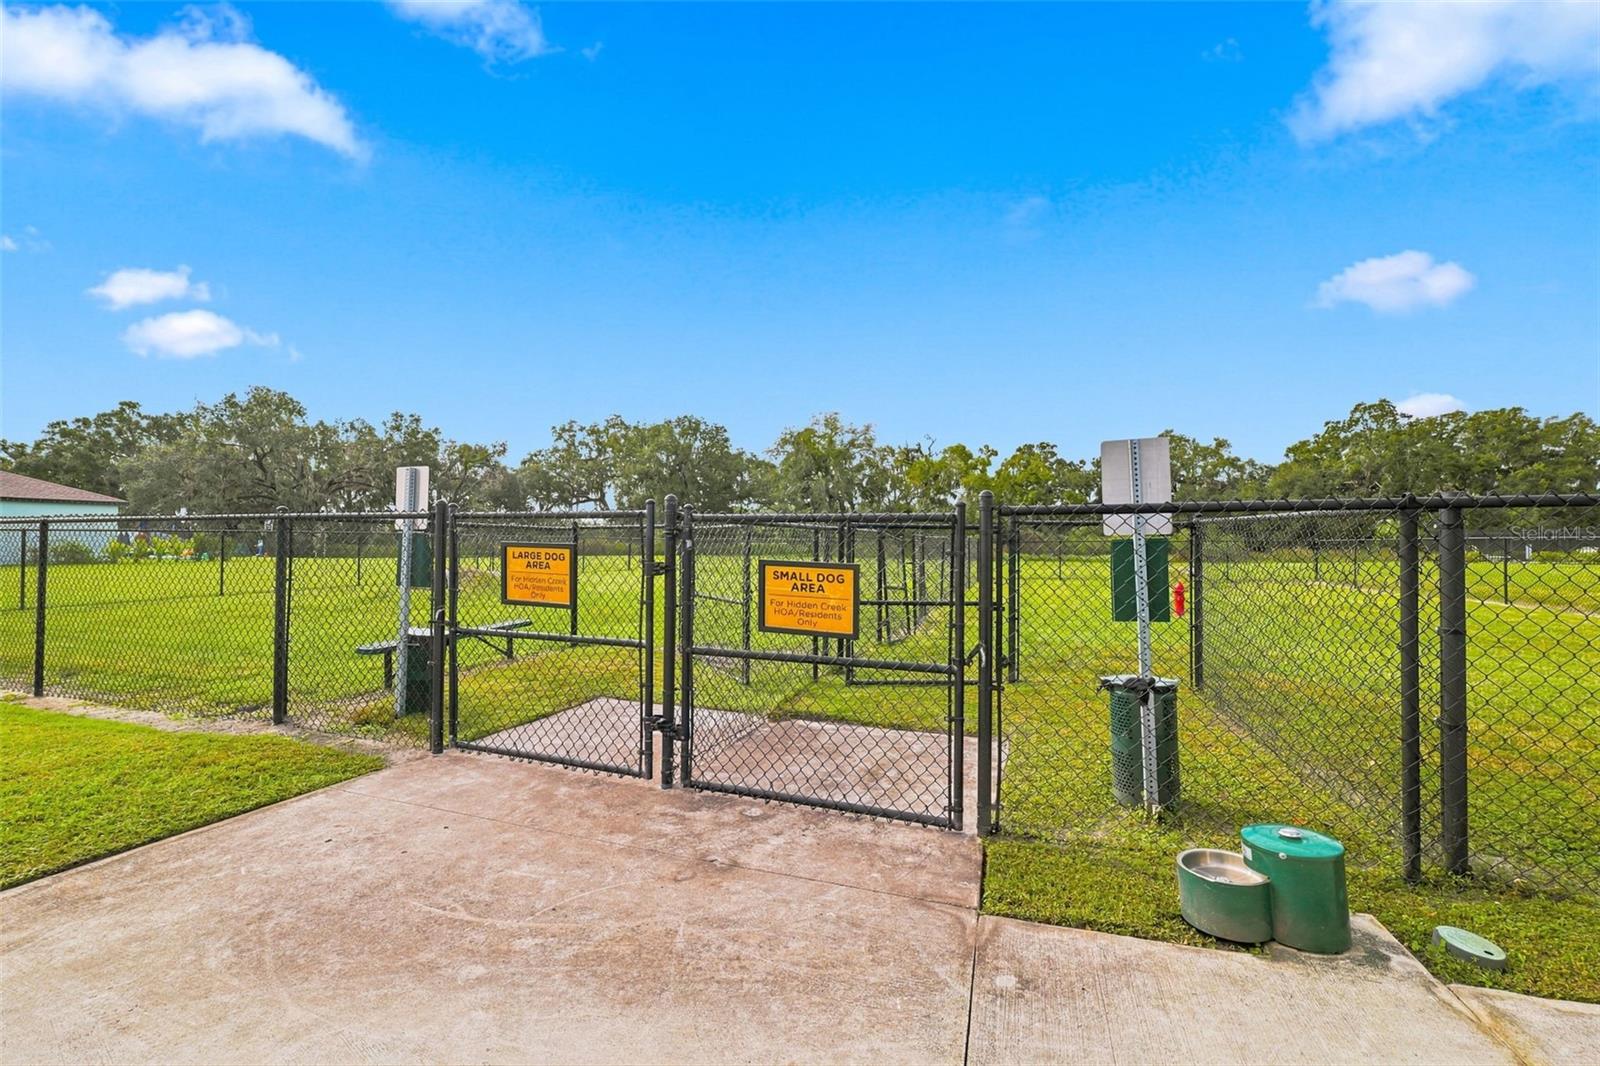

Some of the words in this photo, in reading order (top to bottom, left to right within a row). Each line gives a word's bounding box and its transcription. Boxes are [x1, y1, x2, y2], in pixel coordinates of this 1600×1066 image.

[512, 551, 542, 560] LARGE
[544, 552, 566, 561] DOG
[526, 561, 551, 570] AREA
[511, 575, 522, 583] For
[773, 570, 813, 582] SMALL
[816, 573, 845, 584] DOG
[791, 582, 825, 593] AREA
[530, 591, 546, 600] Only
[770, 599, 784, 607] For
[787, 600, 818, 610] Hidden
[820, 602, 847, 611] Creek
[774, 608, 842, 620] HOA/Residents
[797, 618, 818, 627] Only
